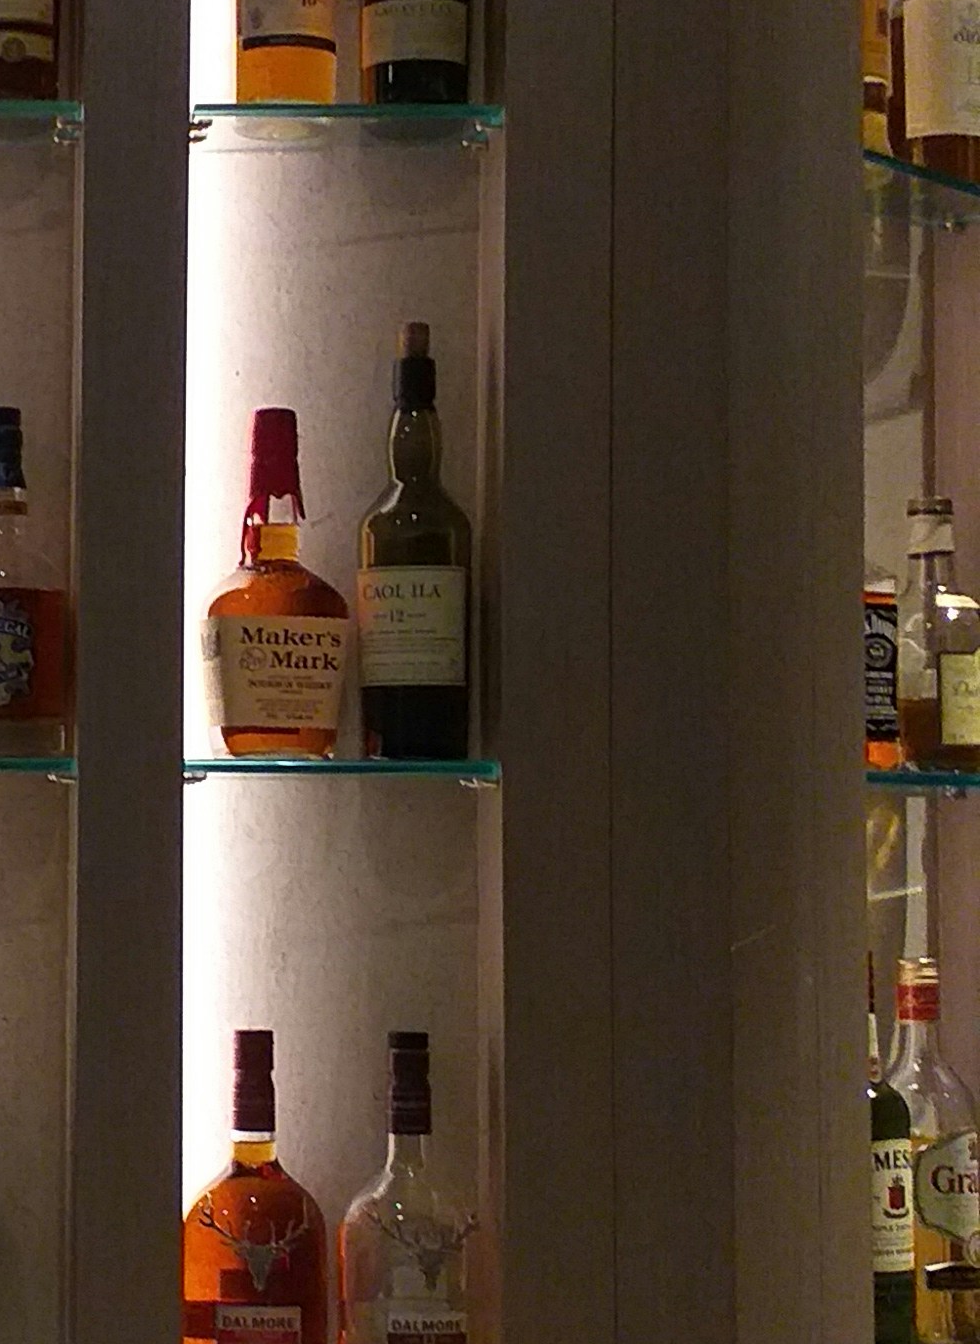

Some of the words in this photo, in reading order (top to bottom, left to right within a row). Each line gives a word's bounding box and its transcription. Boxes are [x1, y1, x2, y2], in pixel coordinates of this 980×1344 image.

[363, 583, 406, 601] CAOL
[411, 582, 442, 598] ILA
[241, 627, 342, 648] Maker's
[269, 651, 340, 671] Mark
[222, 1315, 296, 1329] DALMORE
